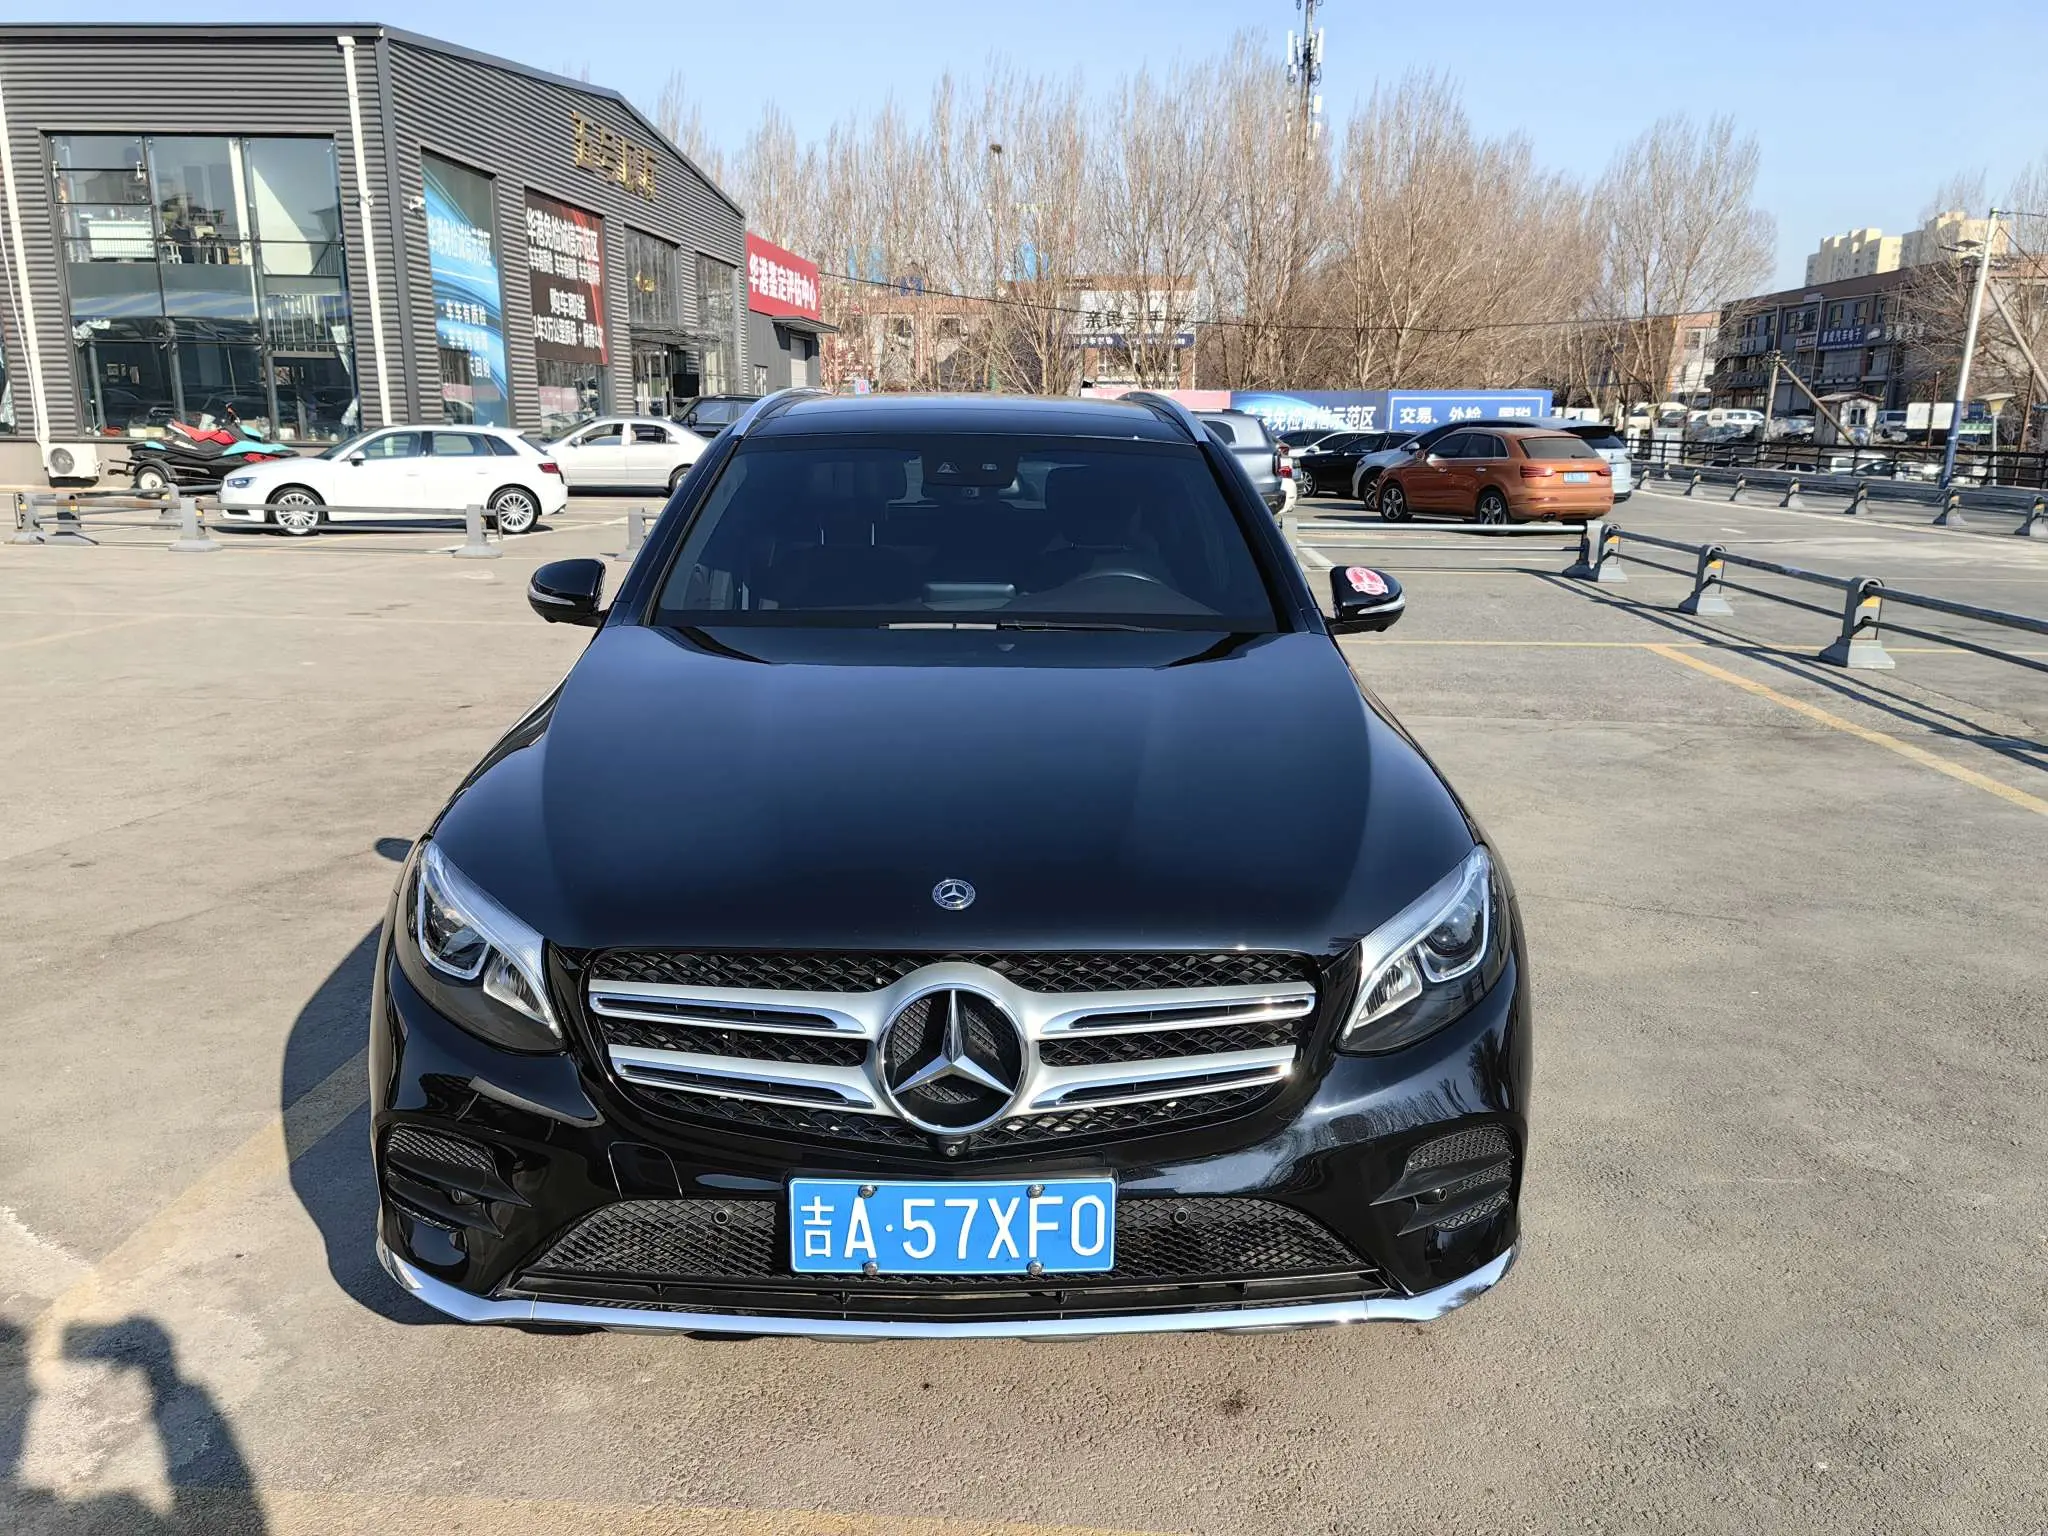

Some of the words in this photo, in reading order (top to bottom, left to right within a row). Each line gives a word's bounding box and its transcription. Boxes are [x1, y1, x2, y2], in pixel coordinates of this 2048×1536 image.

[526, 207, 599, 263] 华港免检诚信示范区
[550, 288, 587, 320] 购车即送
[749, 251, 817, 312] 华港鉴定评估中心
